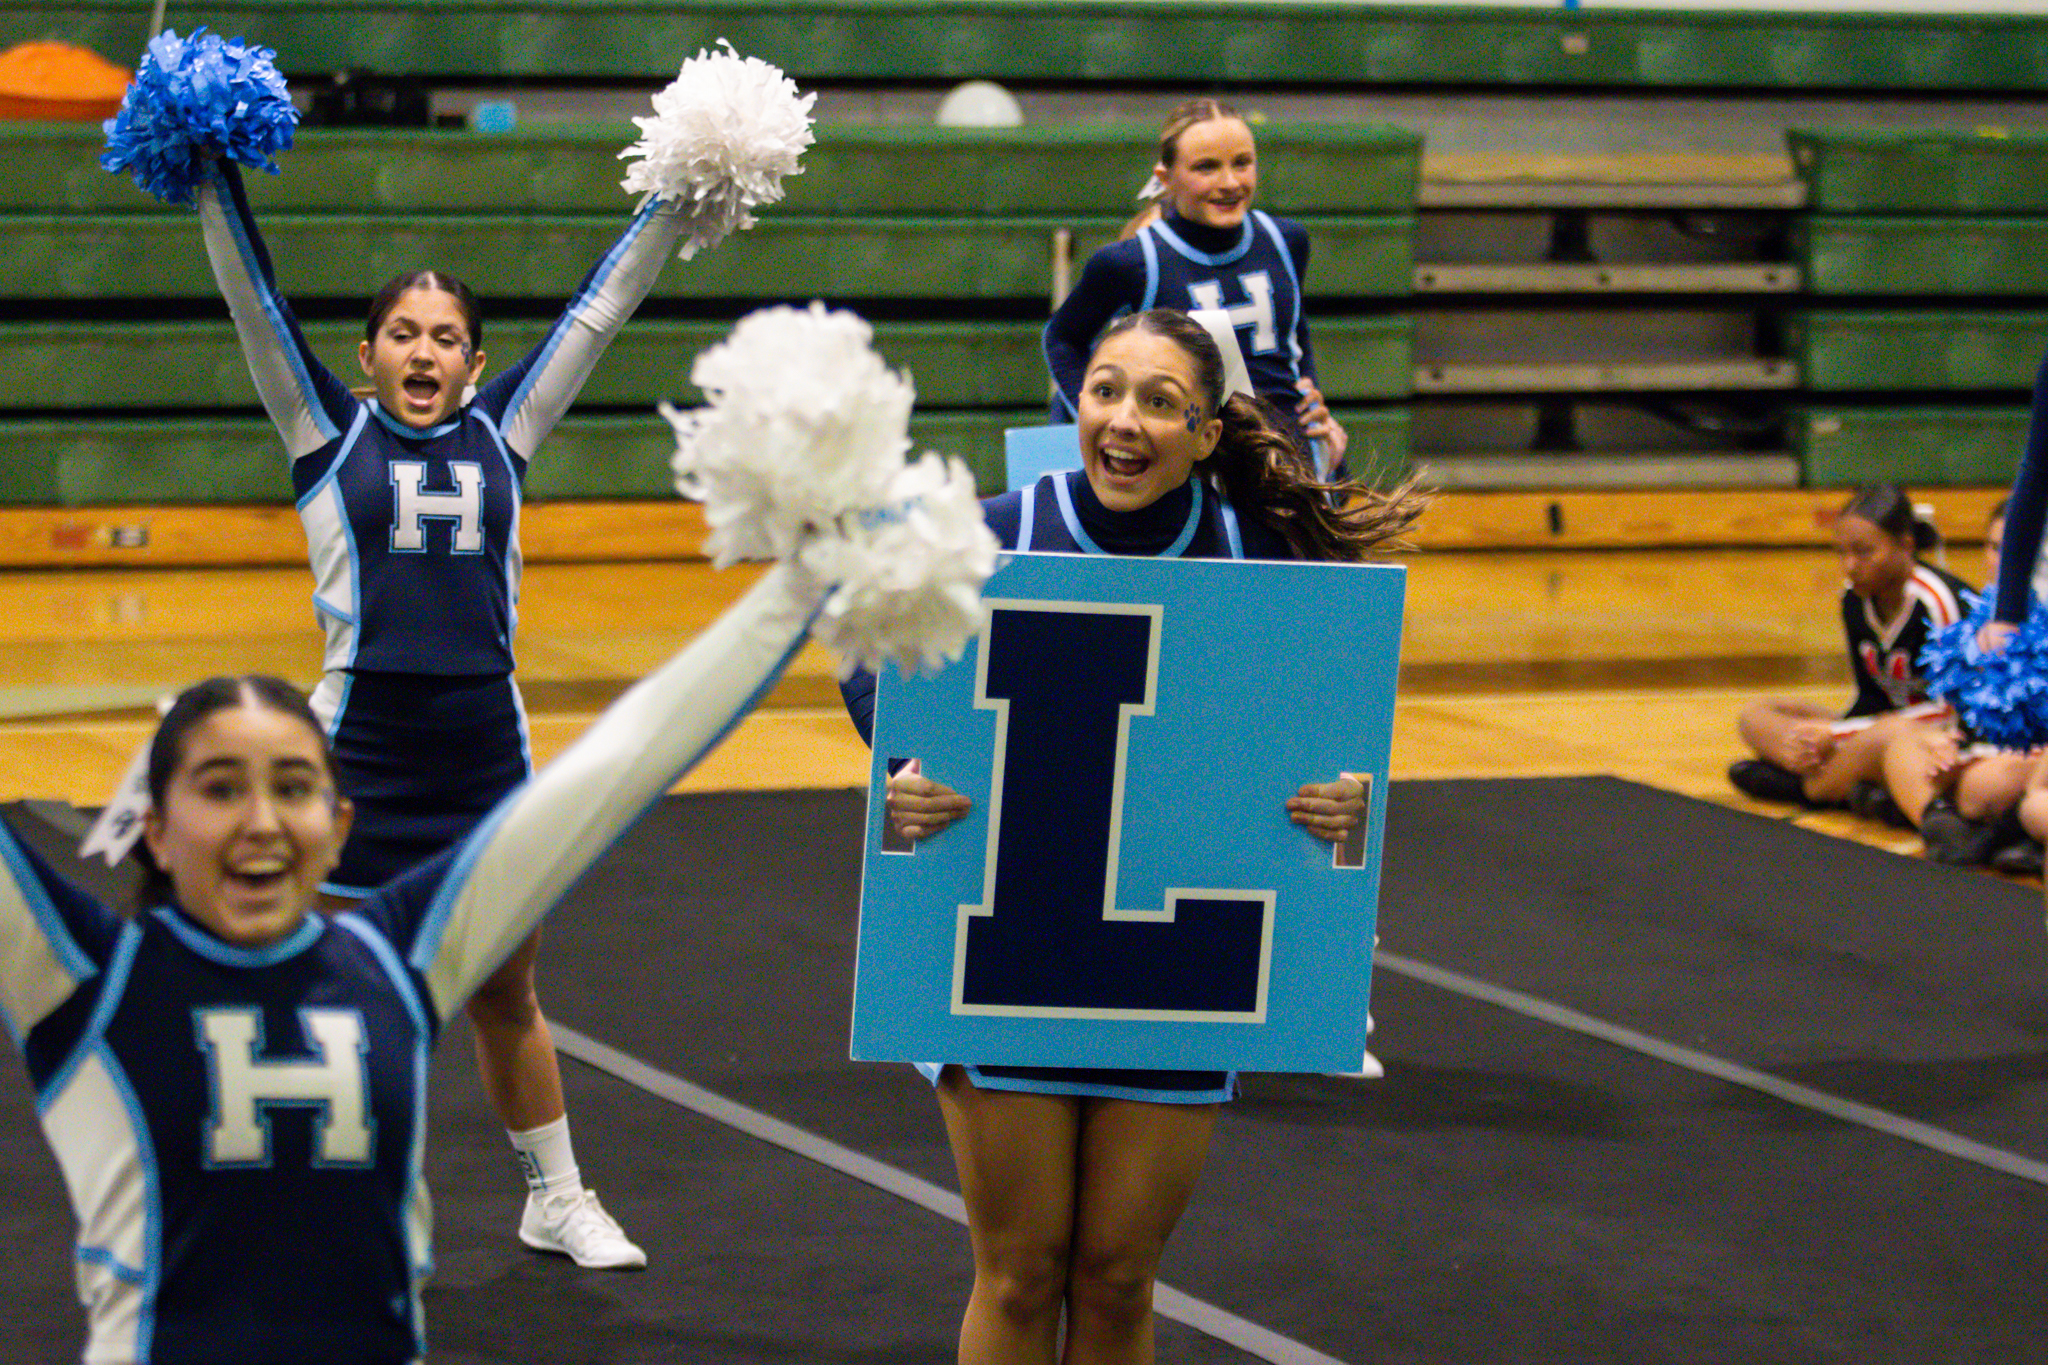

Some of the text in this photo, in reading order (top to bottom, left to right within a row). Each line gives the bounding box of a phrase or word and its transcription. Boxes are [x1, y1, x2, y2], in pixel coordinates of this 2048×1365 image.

[1187, 269, 1279, 355] H
[388, 460, 486, 555] H
[951, 598, 1276, 1023] L
[191, 1005, 378, 1170] H
